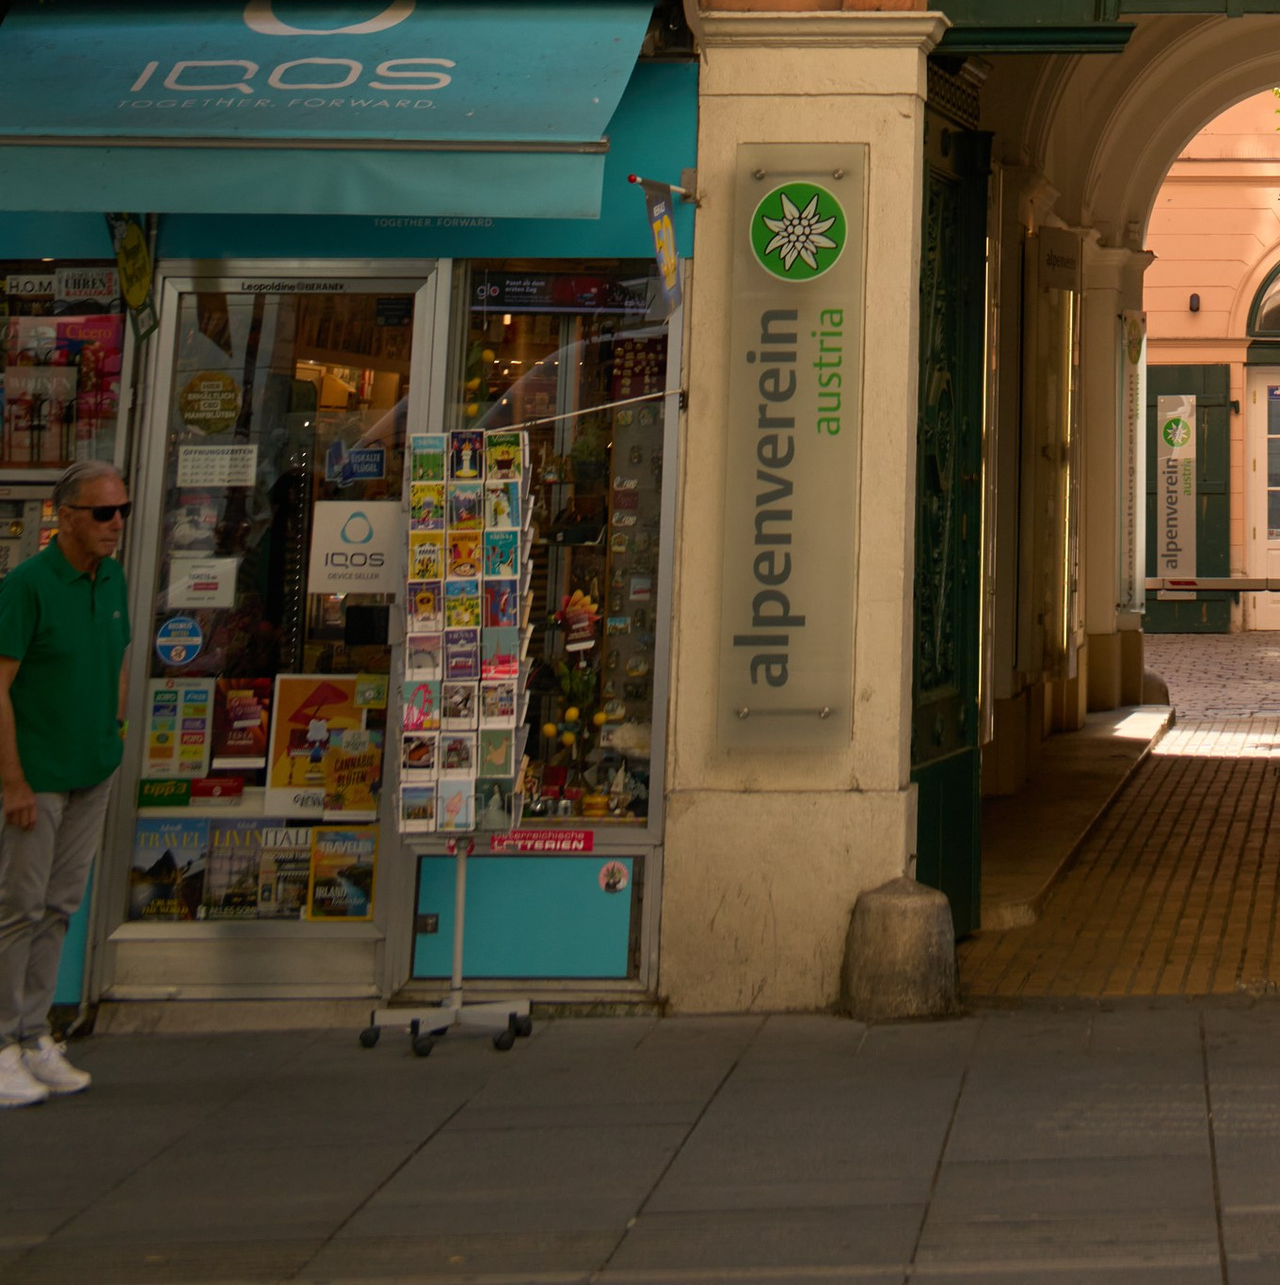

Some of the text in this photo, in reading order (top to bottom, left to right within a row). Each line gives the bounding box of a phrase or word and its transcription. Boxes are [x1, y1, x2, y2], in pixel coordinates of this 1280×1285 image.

[129, 57, 457, 95] IQOS
[117, 97, 437, 109] TOGETHER. FORWARD.
[241, 282, 296, 292] Leopoldine
[476, 282, 501, 300] glo
[65, 324, 113, 339] Cicero
[810, 307, 845, 437] austria
[1181, 457, 1193, 497] austria
[732, 307, 806, 689] alpenverein
[1160, 456, 1179, 570] alpenverein
[324, 552, 385, 568] IQOS
[334, 753, 375, 772] CANNABIS
[143, 780, 188, 798] tipp3
[137, 831, 205, 849] TRAVEL
